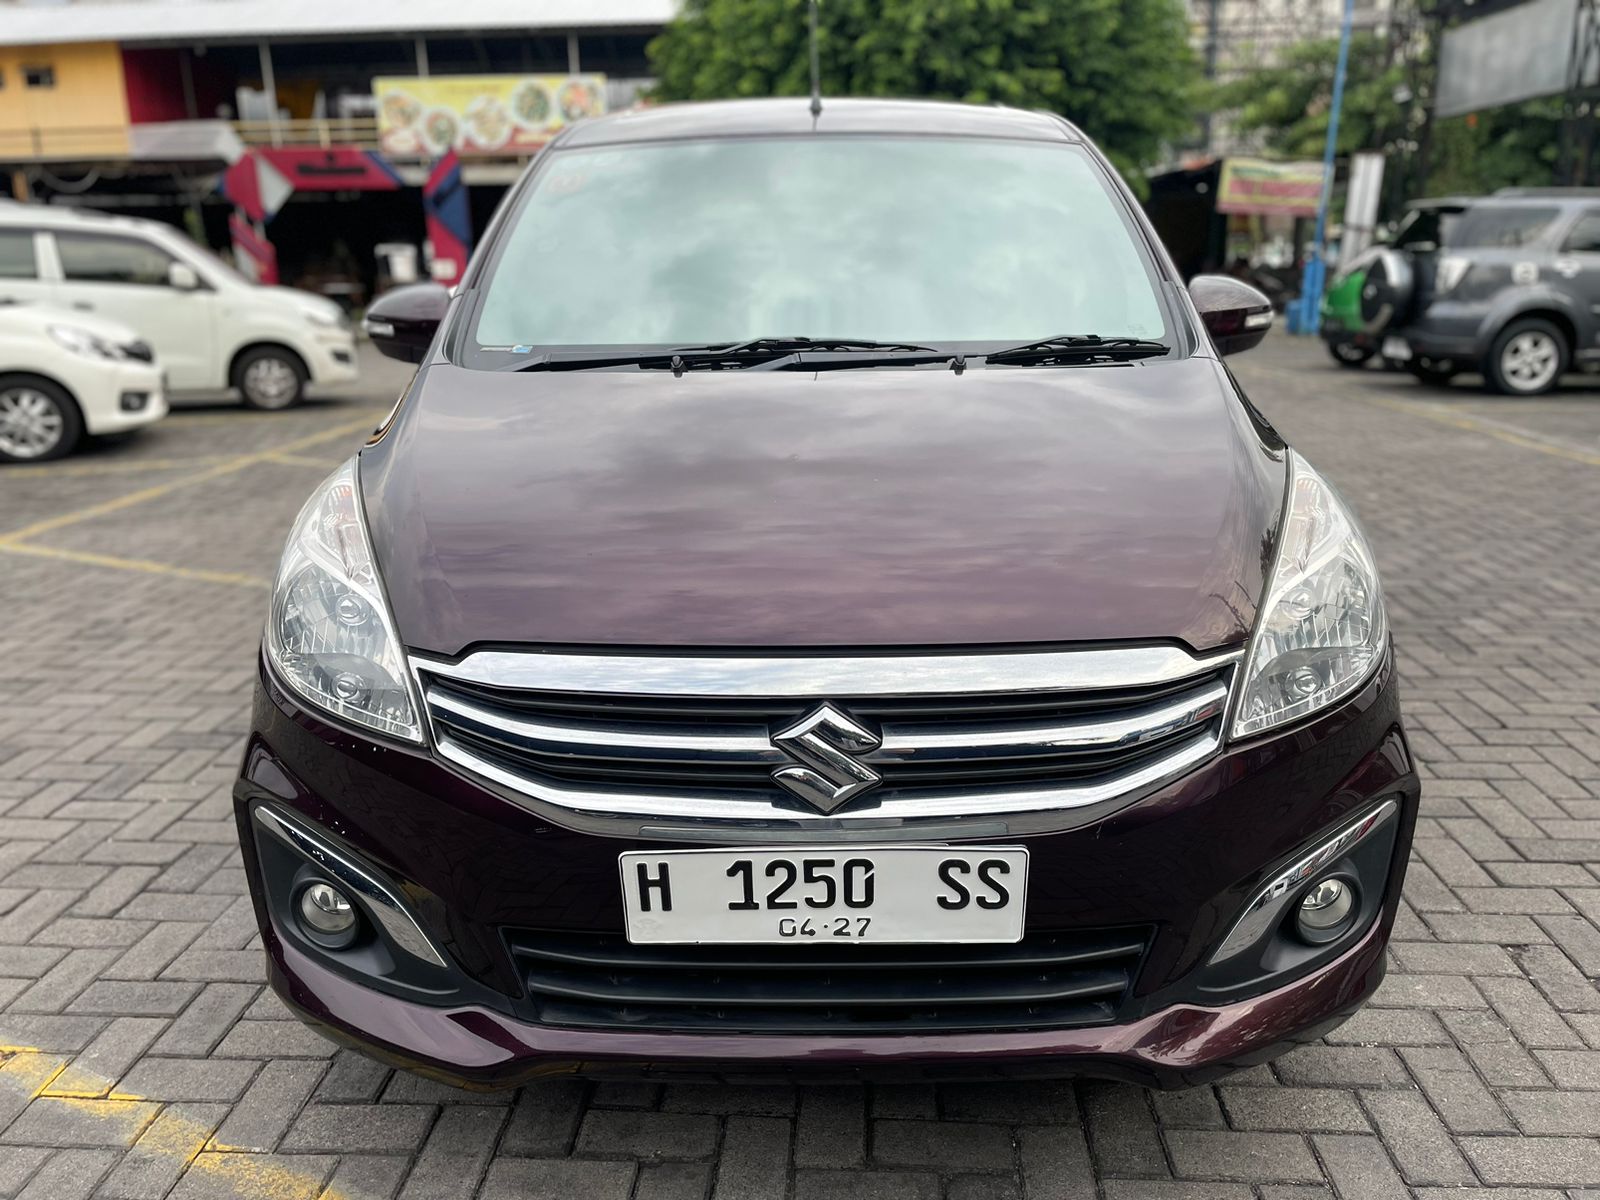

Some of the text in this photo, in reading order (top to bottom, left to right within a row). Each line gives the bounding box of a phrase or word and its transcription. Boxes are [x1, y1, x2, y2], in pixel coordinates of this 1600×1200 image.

[636, 858, 1011, 912] H 1250 SS
